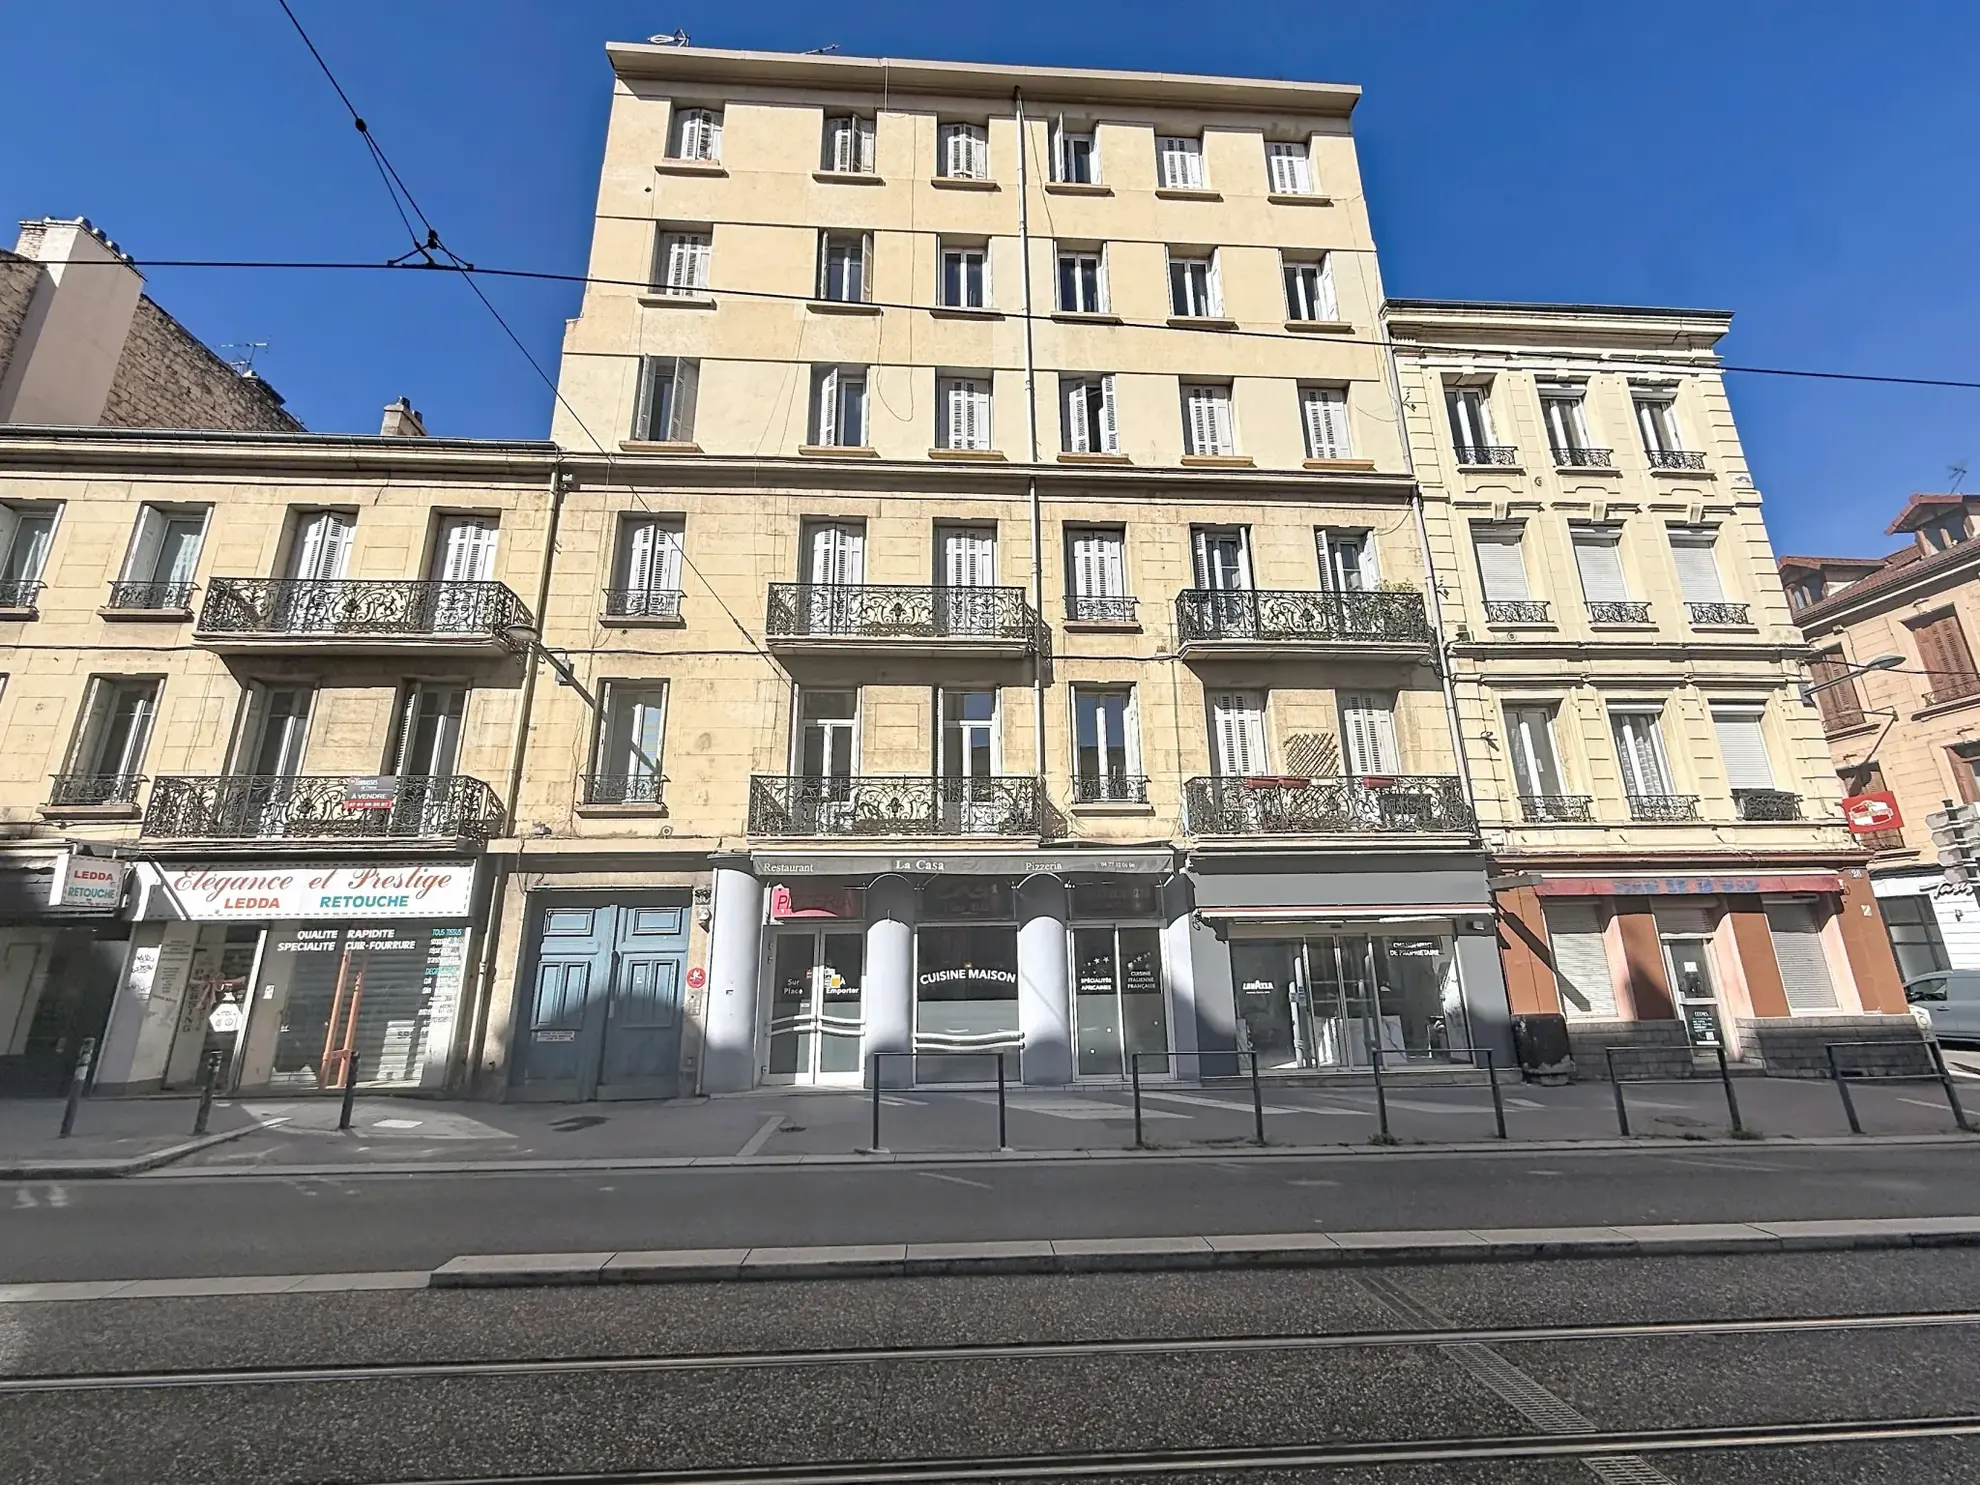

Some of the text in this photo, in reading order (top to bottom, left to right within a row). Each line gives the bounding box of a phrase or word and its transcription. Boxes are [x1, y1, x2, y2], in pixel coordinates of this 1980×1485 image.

[763, 862, 814, 873] Restaurant
[895, 859, 945, 871] La Casa
[1025, 861, 1062, 872] Pizzeria
[74, 870, 114, 881] LEDDA
[308, 867, 339, 889] et
[348, 864, 452, 899] Prestige
[68, 887, 115, 899] RETOUCHE
[224, 895, 409, 909] LEDDA RETOUCHE
[777, 895, 852, 910] PIERIA
[297, 929, 395, 940] QUALITE RAPIDITE
[277, 940, 416, 951] SPECIALITE CUIR-FOURRURE
[788, 978, 800, 986] Sur
[920, 969, 1016, 985] CUISINE MAISON
[826, 987, 859, 995] Emporter
